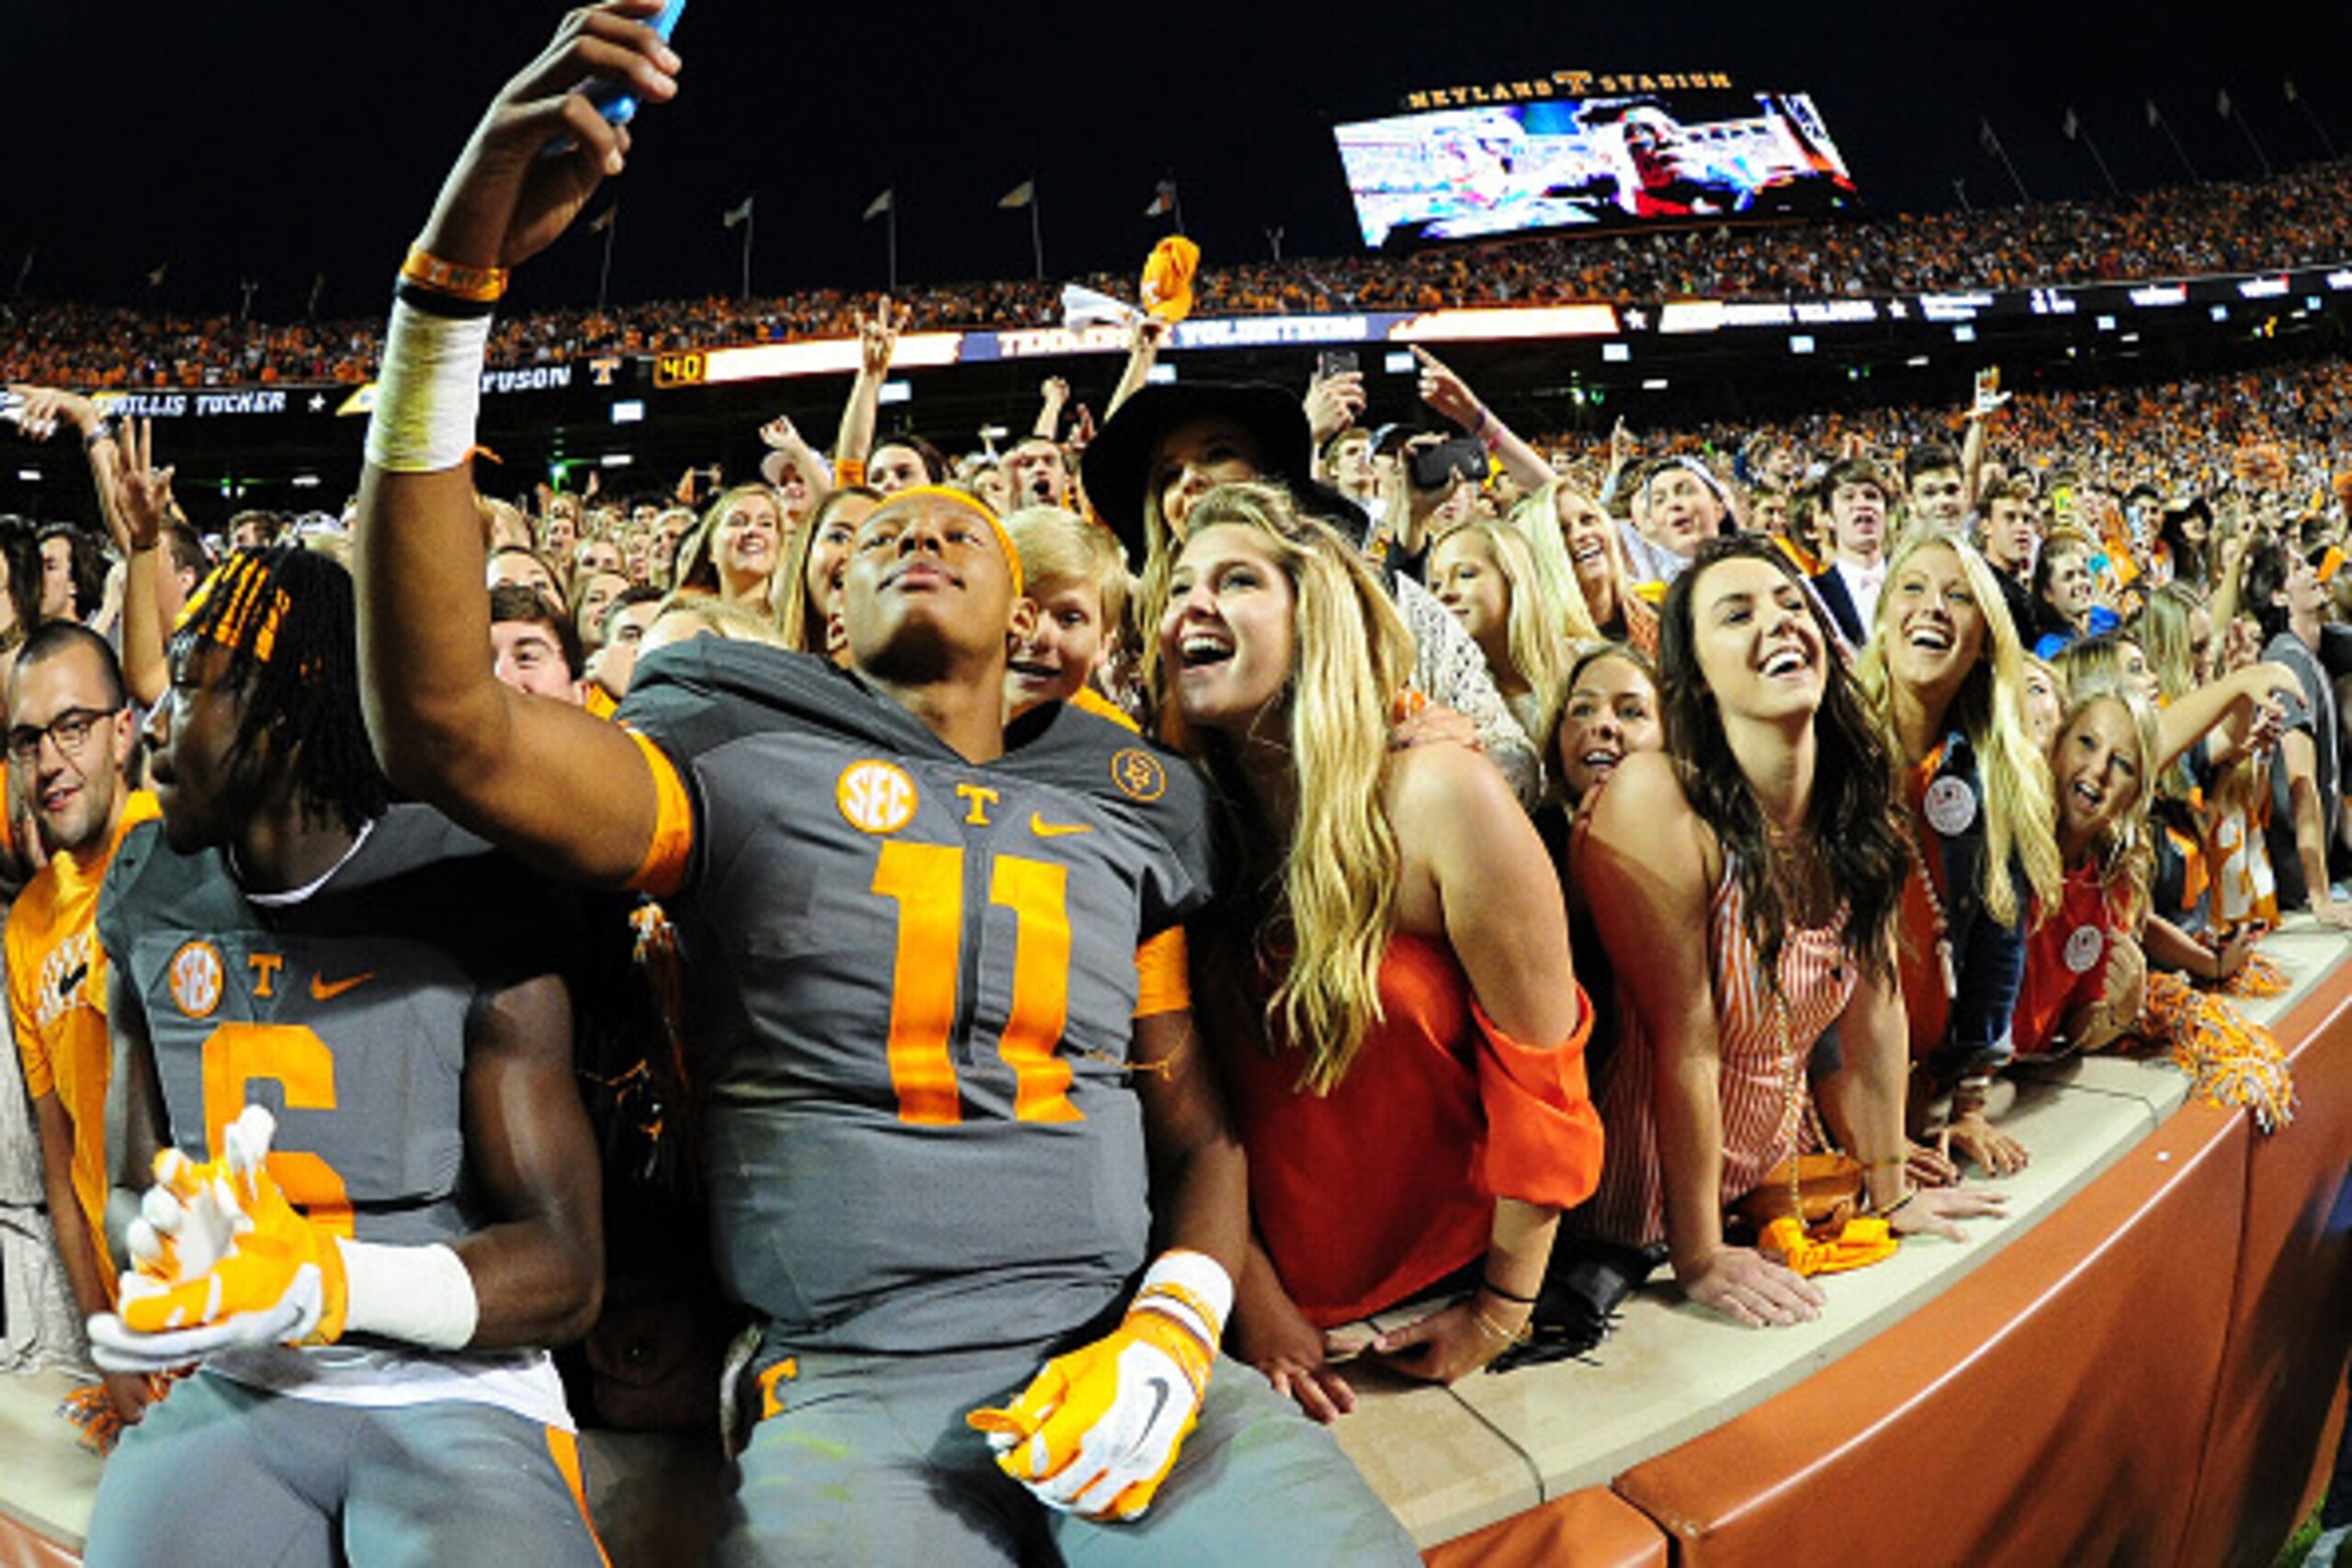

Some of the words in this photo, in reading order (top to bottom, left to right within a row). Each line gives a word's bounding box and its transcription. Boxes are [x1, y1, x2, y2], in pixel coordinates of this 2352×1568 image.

[662, 354, 699, 380] 40
[195, 391, 286, 415] TUCKER
[844, 765, 911, 829] SEC
[956, 783, 999, 825] T
[175, 947, 219, 1011] SEC
[247, 953, 283, 998] T
[871, 838, 1087, 1125] 11
